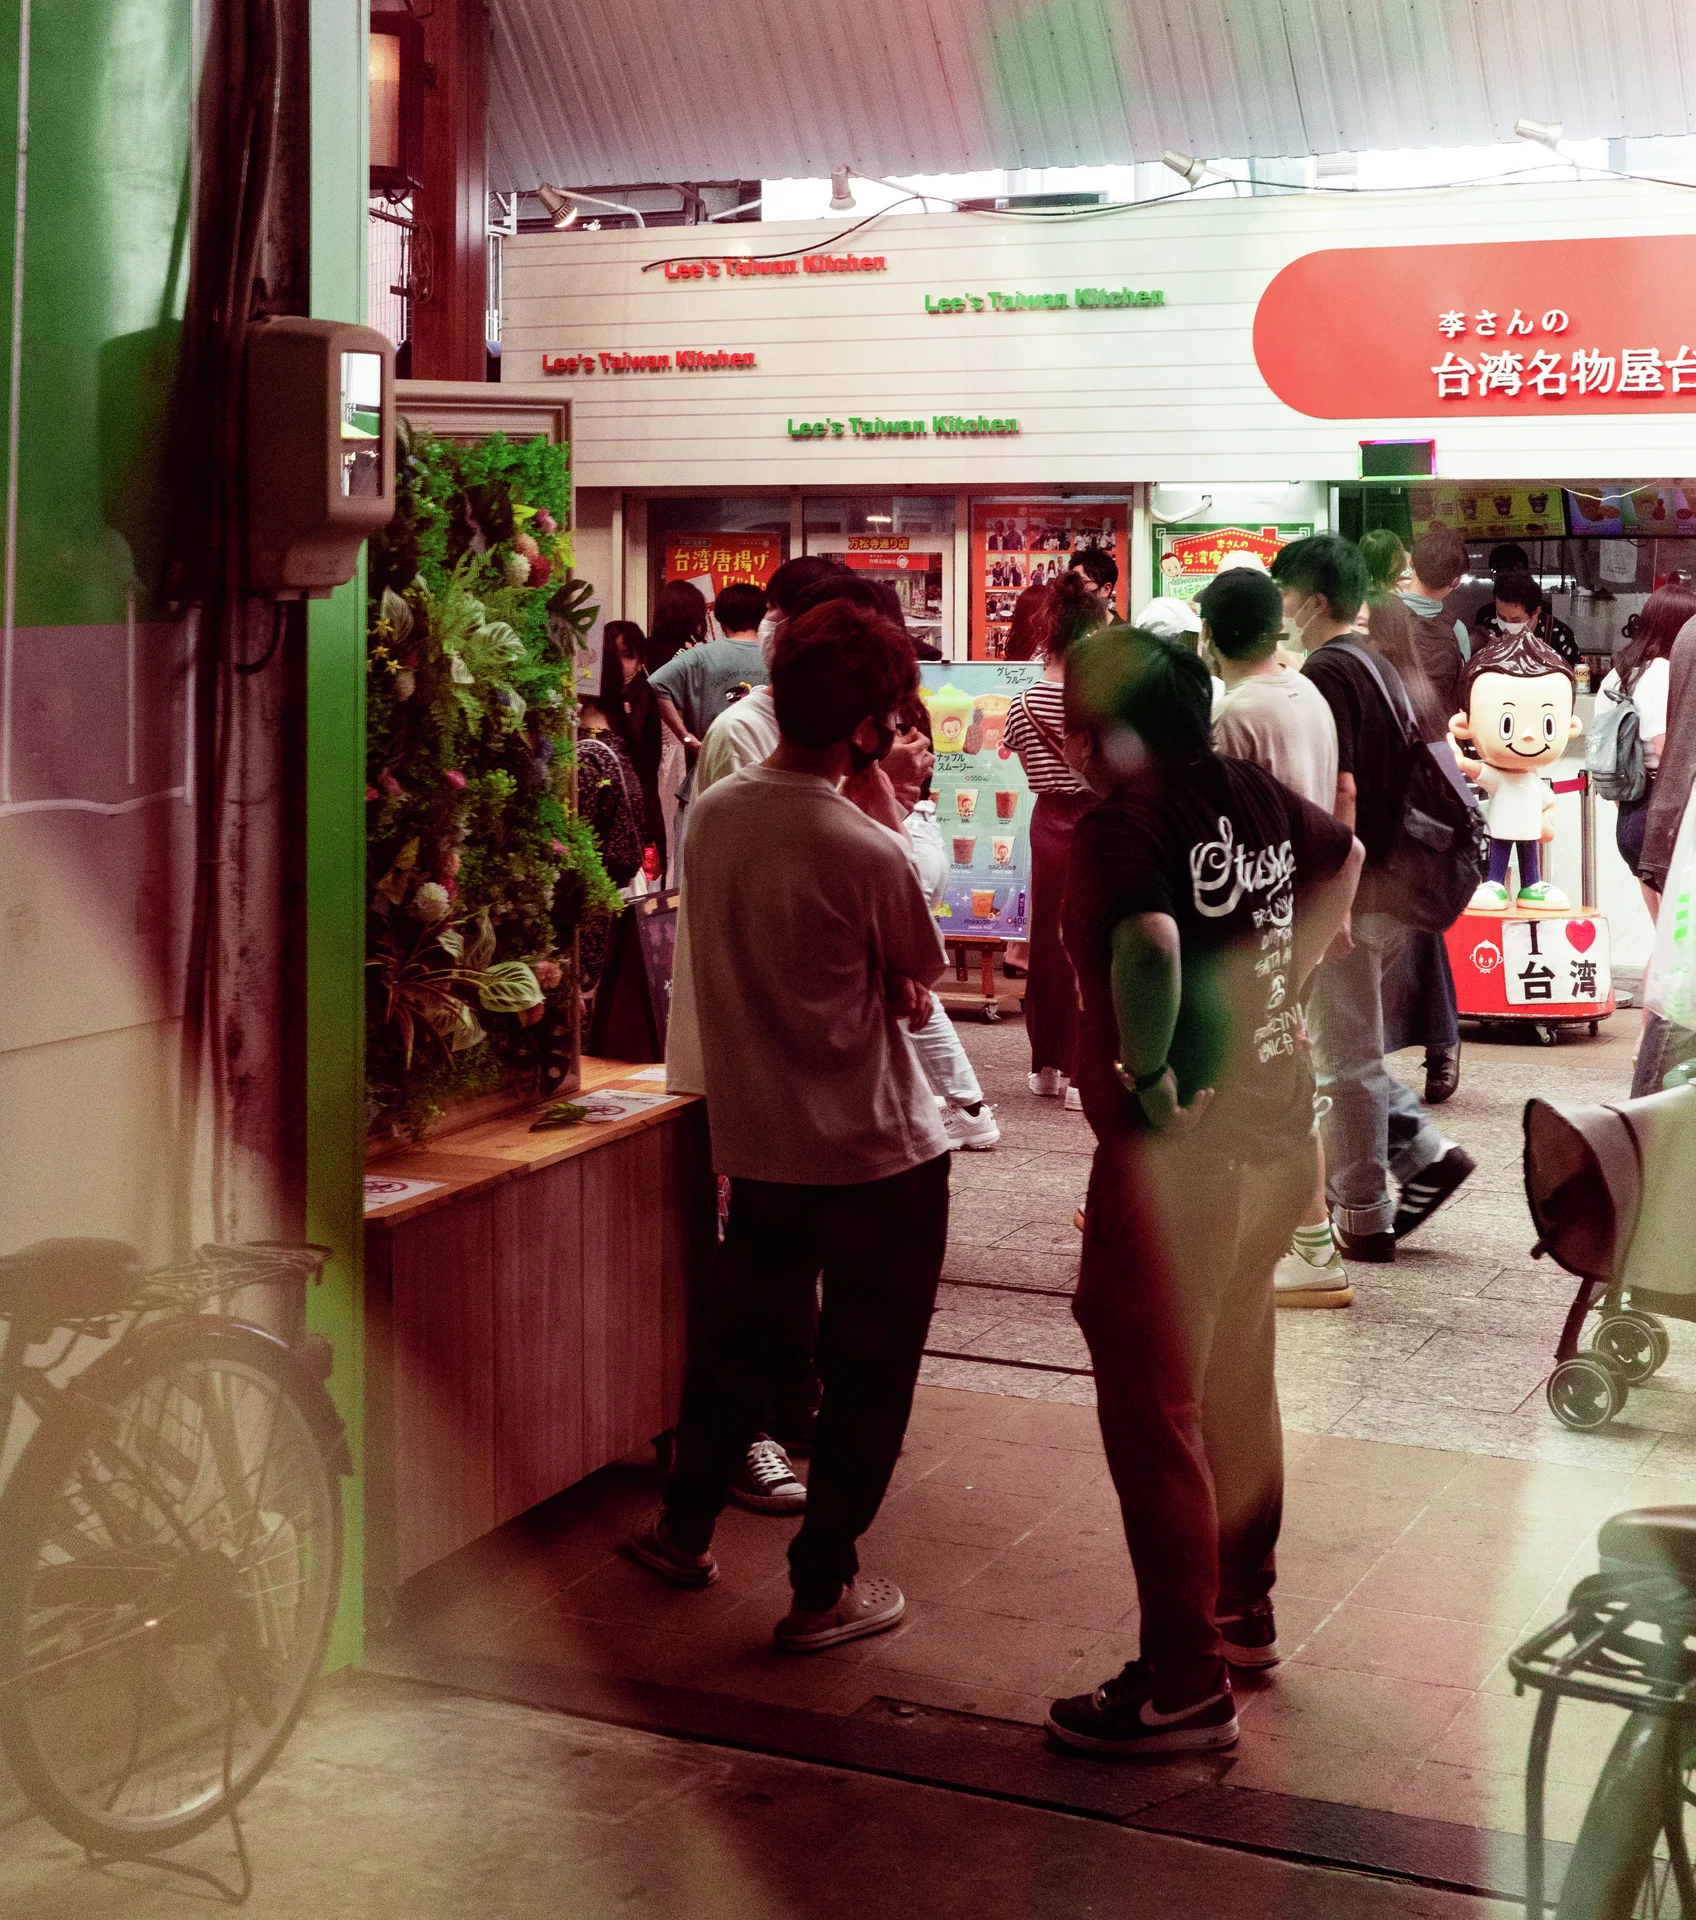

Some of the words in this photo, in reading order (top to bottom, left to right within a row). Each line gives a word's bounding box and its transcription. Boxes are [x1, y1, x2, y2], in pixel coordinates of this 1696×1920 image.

[664, 260, 720, 279] Lee's
[722, 257, 798, 276] Taiwan
[803, 253, 887, 272] Kitchen
[925, 292, 984, 311] Lee's
[988, 290, 1068, 308] Taiwan
[1075, 287, 1164, 306] Kitchen
[1438, 309, 1570, 339] 李さんの
[542, 353, 596, 372] Lee's
[598, 351, 671, 370] Taiwan
[675, 349, 756, 368] Kitchen
[1431, 345, 1696, 398] 台湾名物屋台
[787, 417, 844, 435] Lee's
[848, 417, 926, 434] Taiwan
[932, 415, 1018, 433] Kitchen
[674, 548, 770, 573] 台湾唐揚げ
[1527, 920, 1543, 956] I
[1518, 959, 1598, 1000] 台湾
